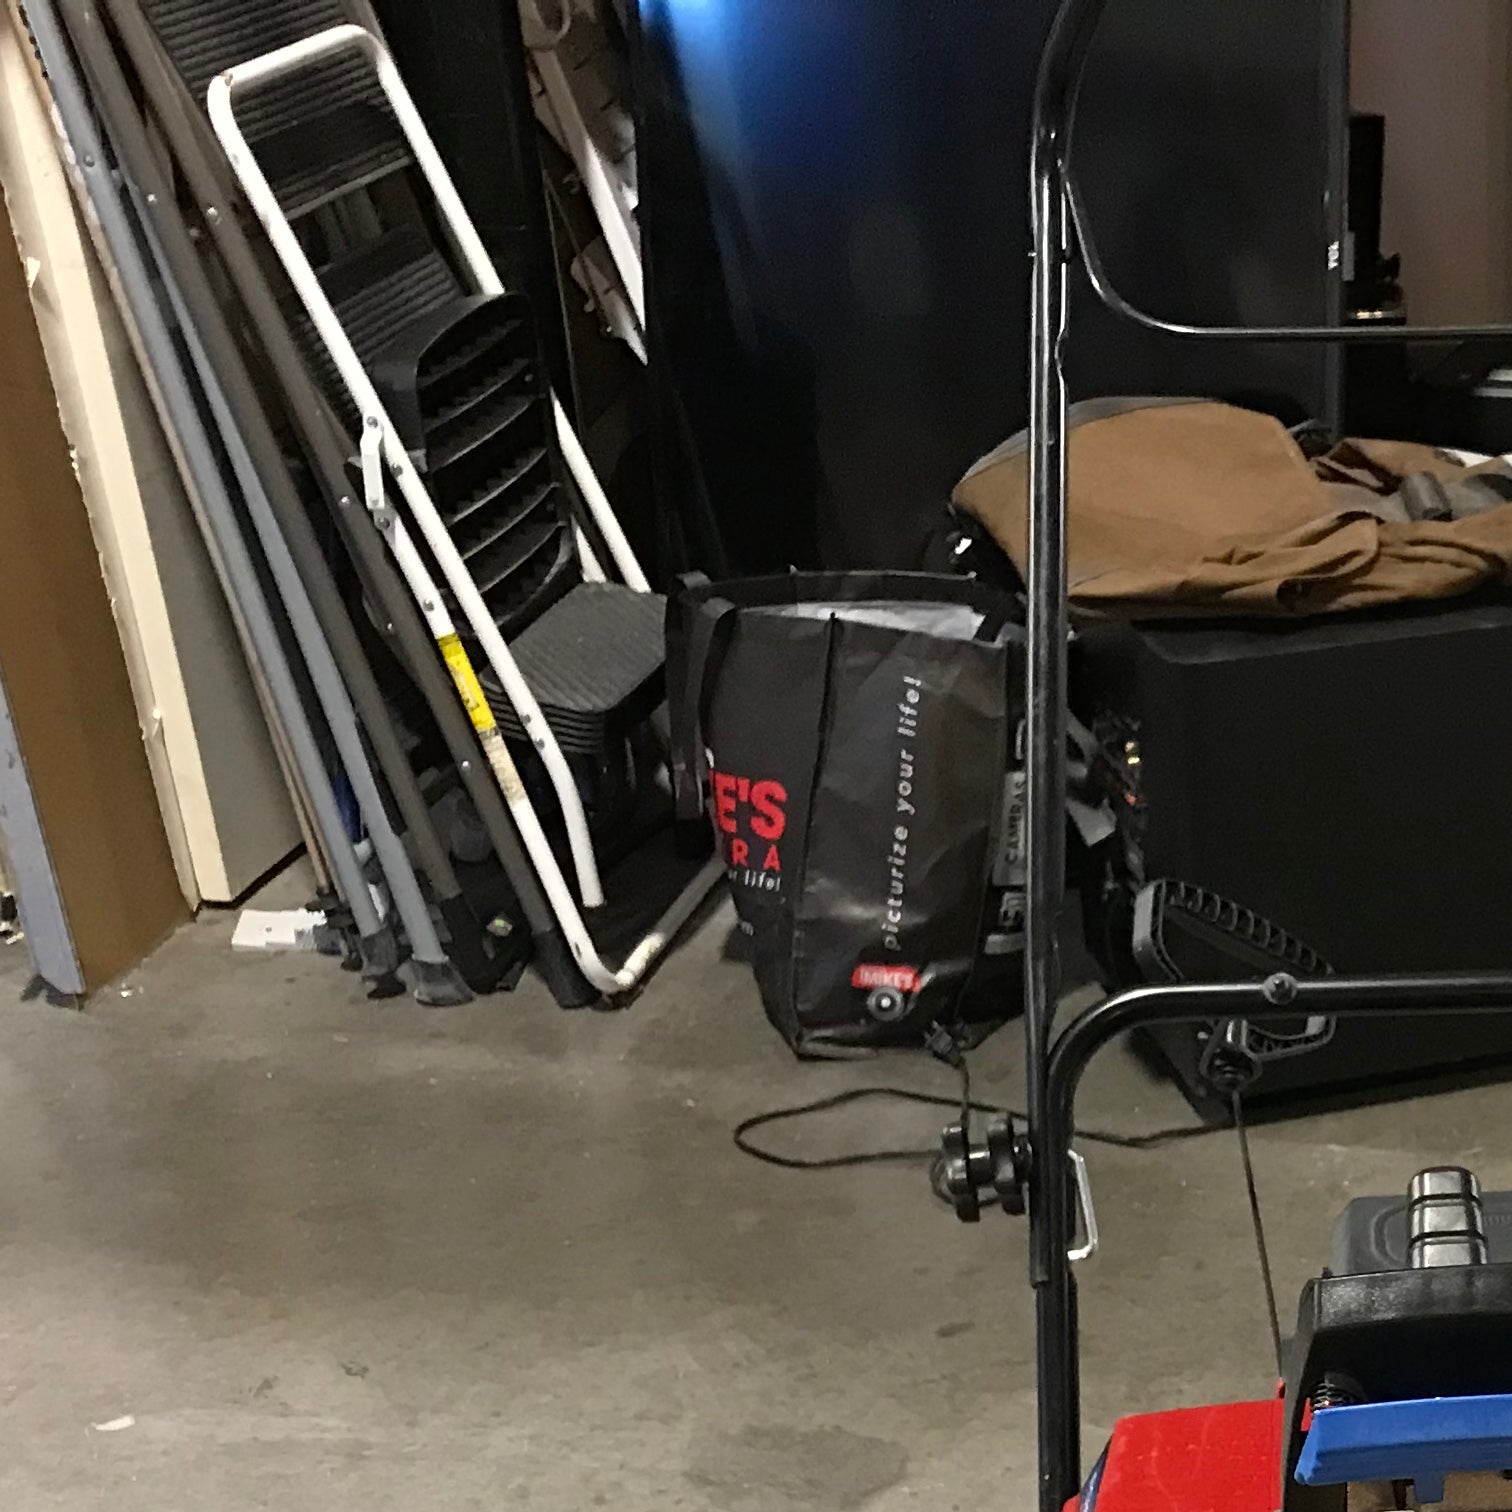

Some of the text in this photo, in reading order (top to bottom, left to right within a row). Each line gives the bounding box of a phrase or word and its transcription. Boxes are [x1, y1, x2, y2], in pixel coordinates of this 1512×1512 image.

[881, 675, 922, 950] picturize your life!
